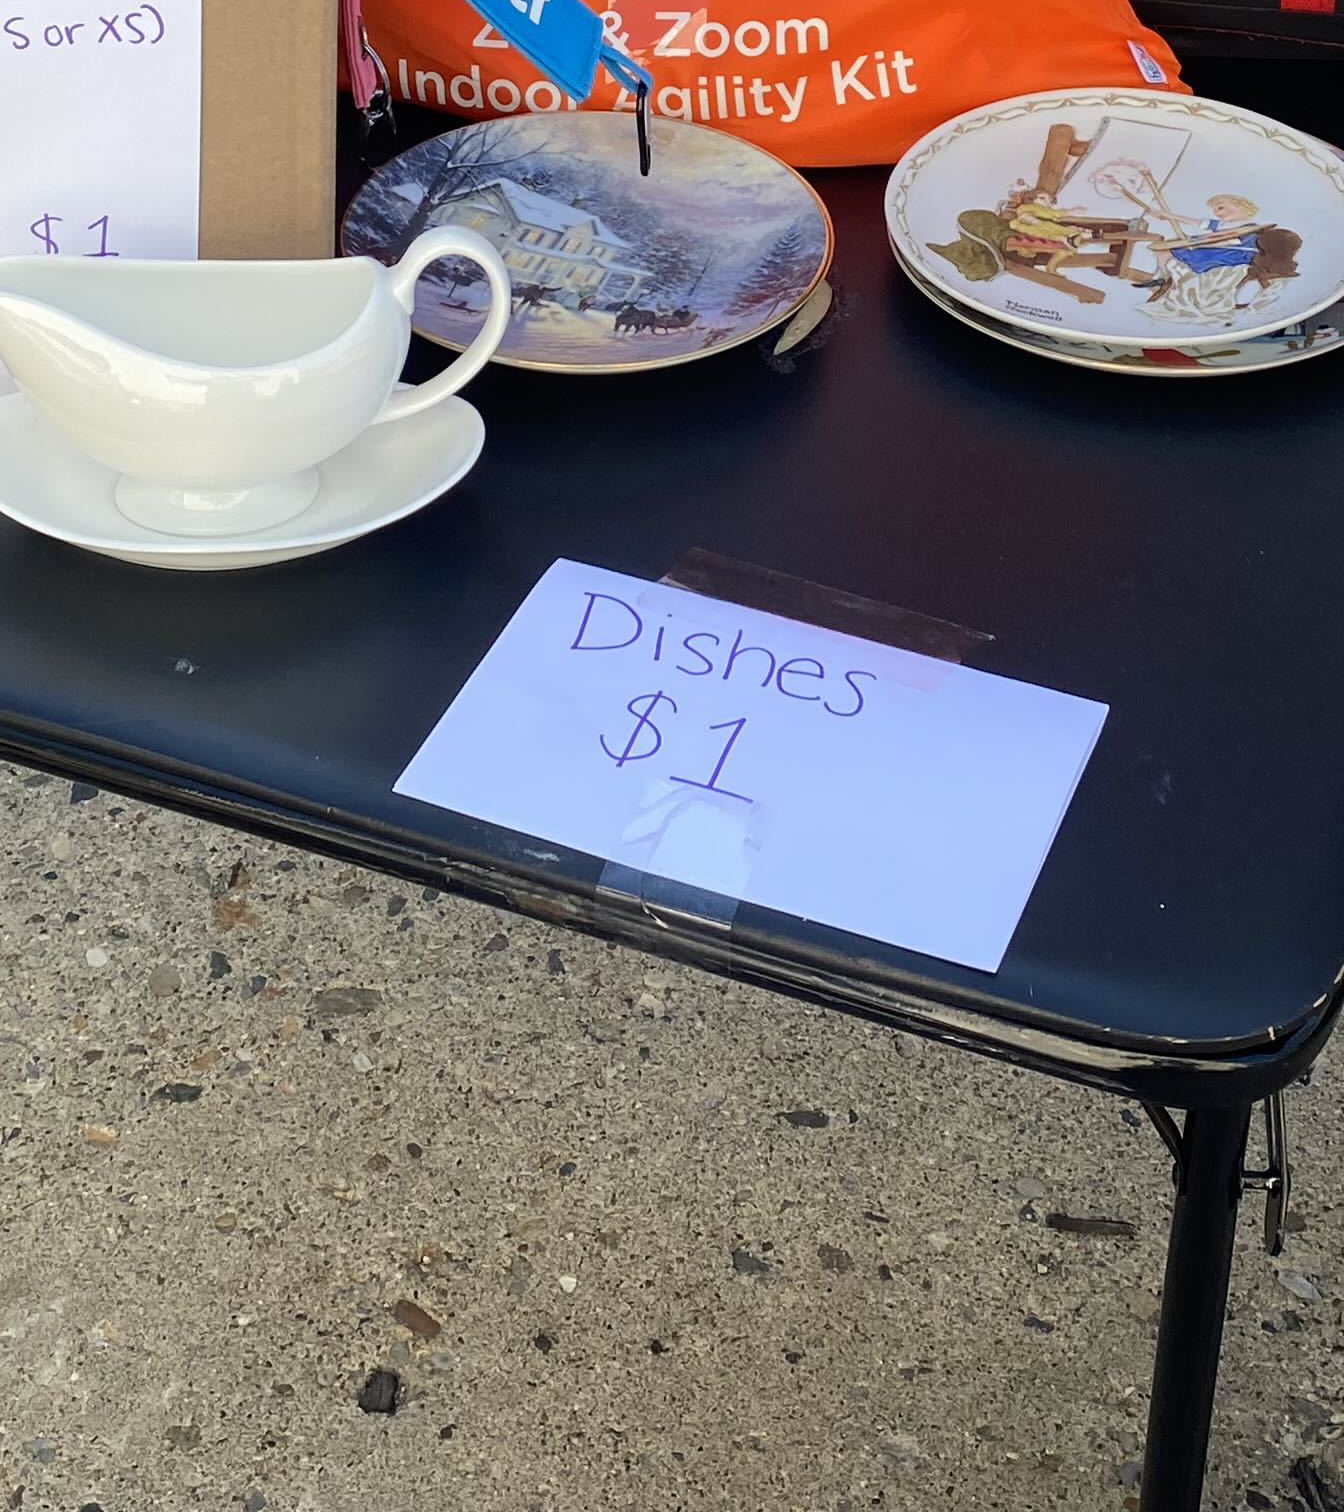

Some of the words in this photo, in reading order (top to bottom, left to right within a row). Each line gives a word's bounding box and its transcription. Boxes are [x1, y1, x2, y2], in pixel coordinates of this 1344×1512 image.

[40, 18, 86, 50] or
[653, 11, 829, 58] Zoom
[831, 49, 917, 105] Kit
[29, 210, 122, 260] $1
[569, 589, 878, 719] Dishes
[599, 689, 755, 805] $1
